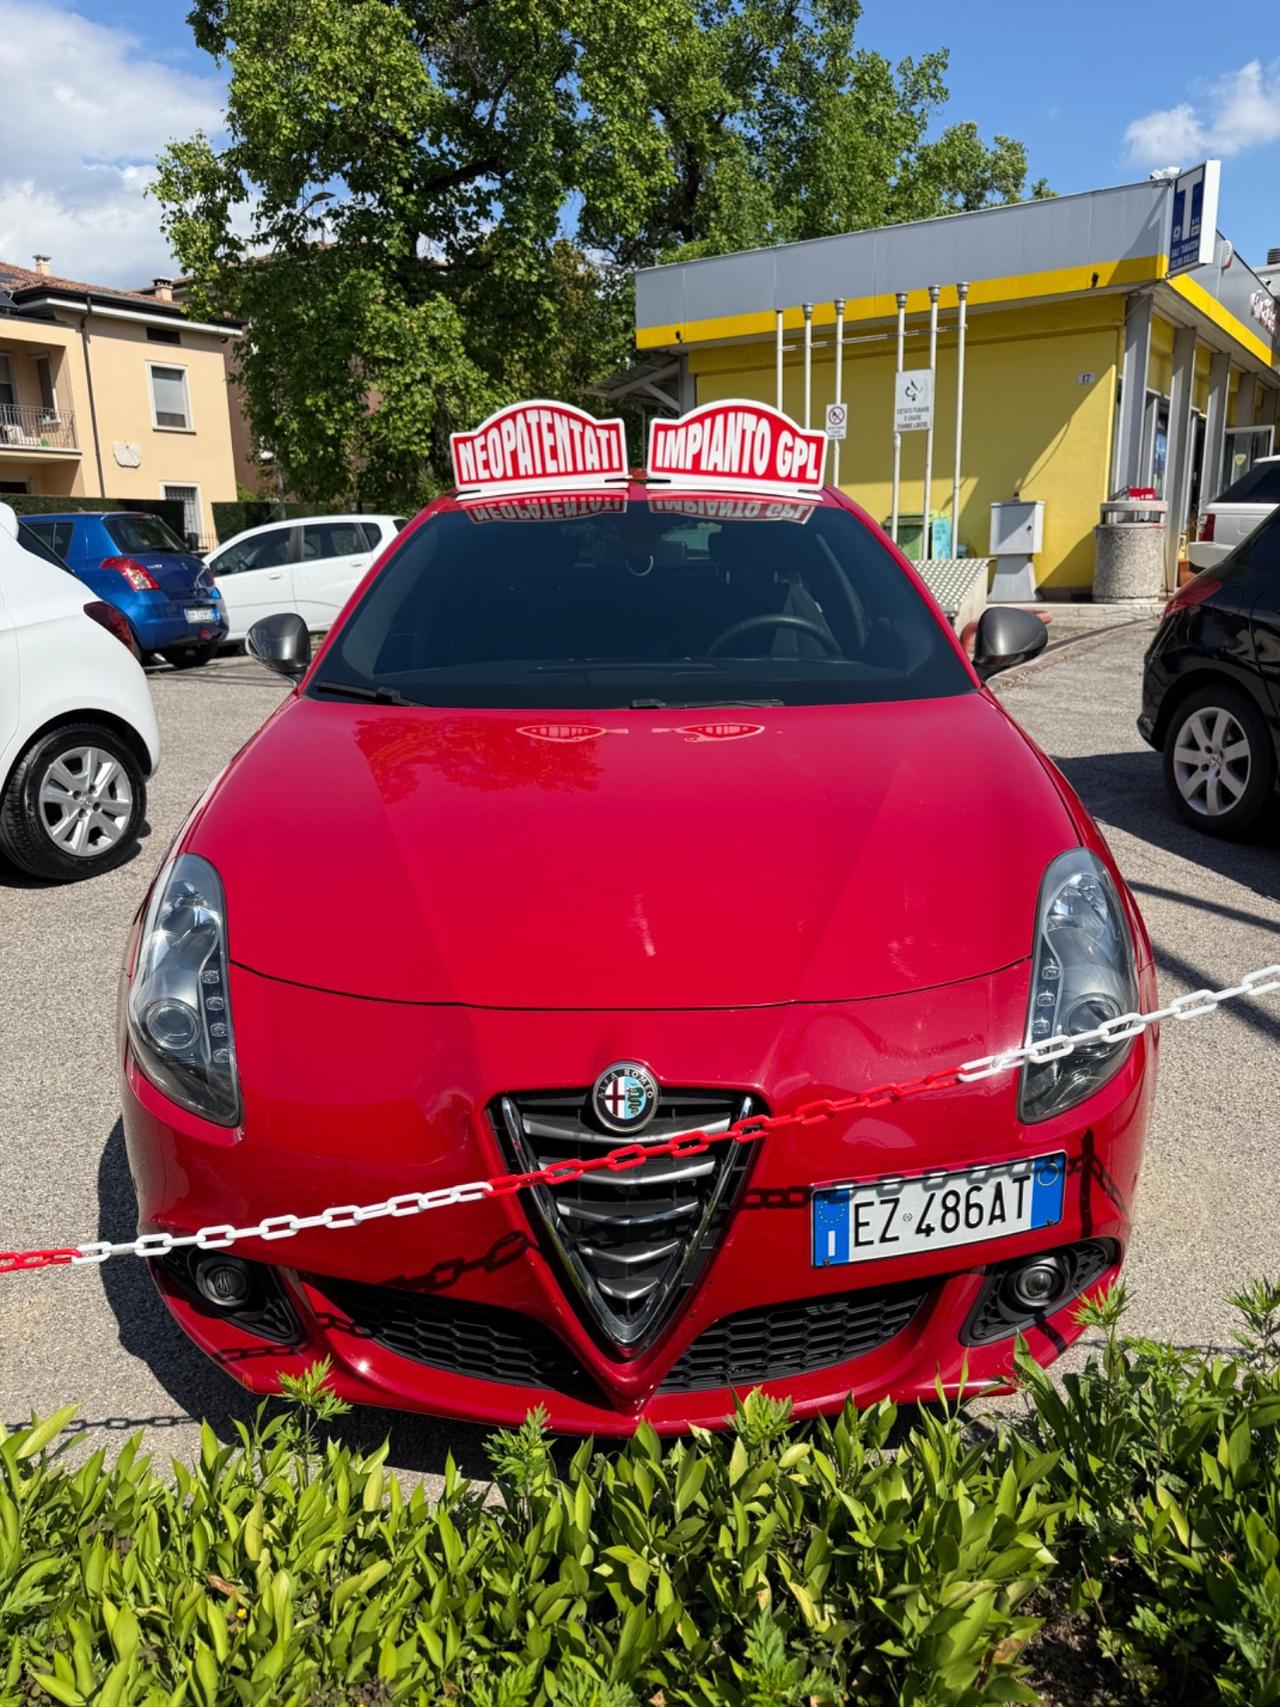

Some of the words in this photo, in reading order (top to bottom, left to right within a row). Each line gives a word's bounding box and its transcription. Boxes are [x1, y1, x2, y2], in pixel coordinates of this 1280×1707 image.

[1177, 167, 1203, 241] T
[458, 409, 621, 481] NEOPATENTATI
[656, 412, 771, 476] IMPIANTO
[776, 430, 818, 480] GPL
[624, 1069, 654, 1099] ROMEO
[828, 1230, 836, 1257] I
[854, 1197, 900, 1247] EZ
[915, 1175, 1031, 1237] 486AT
